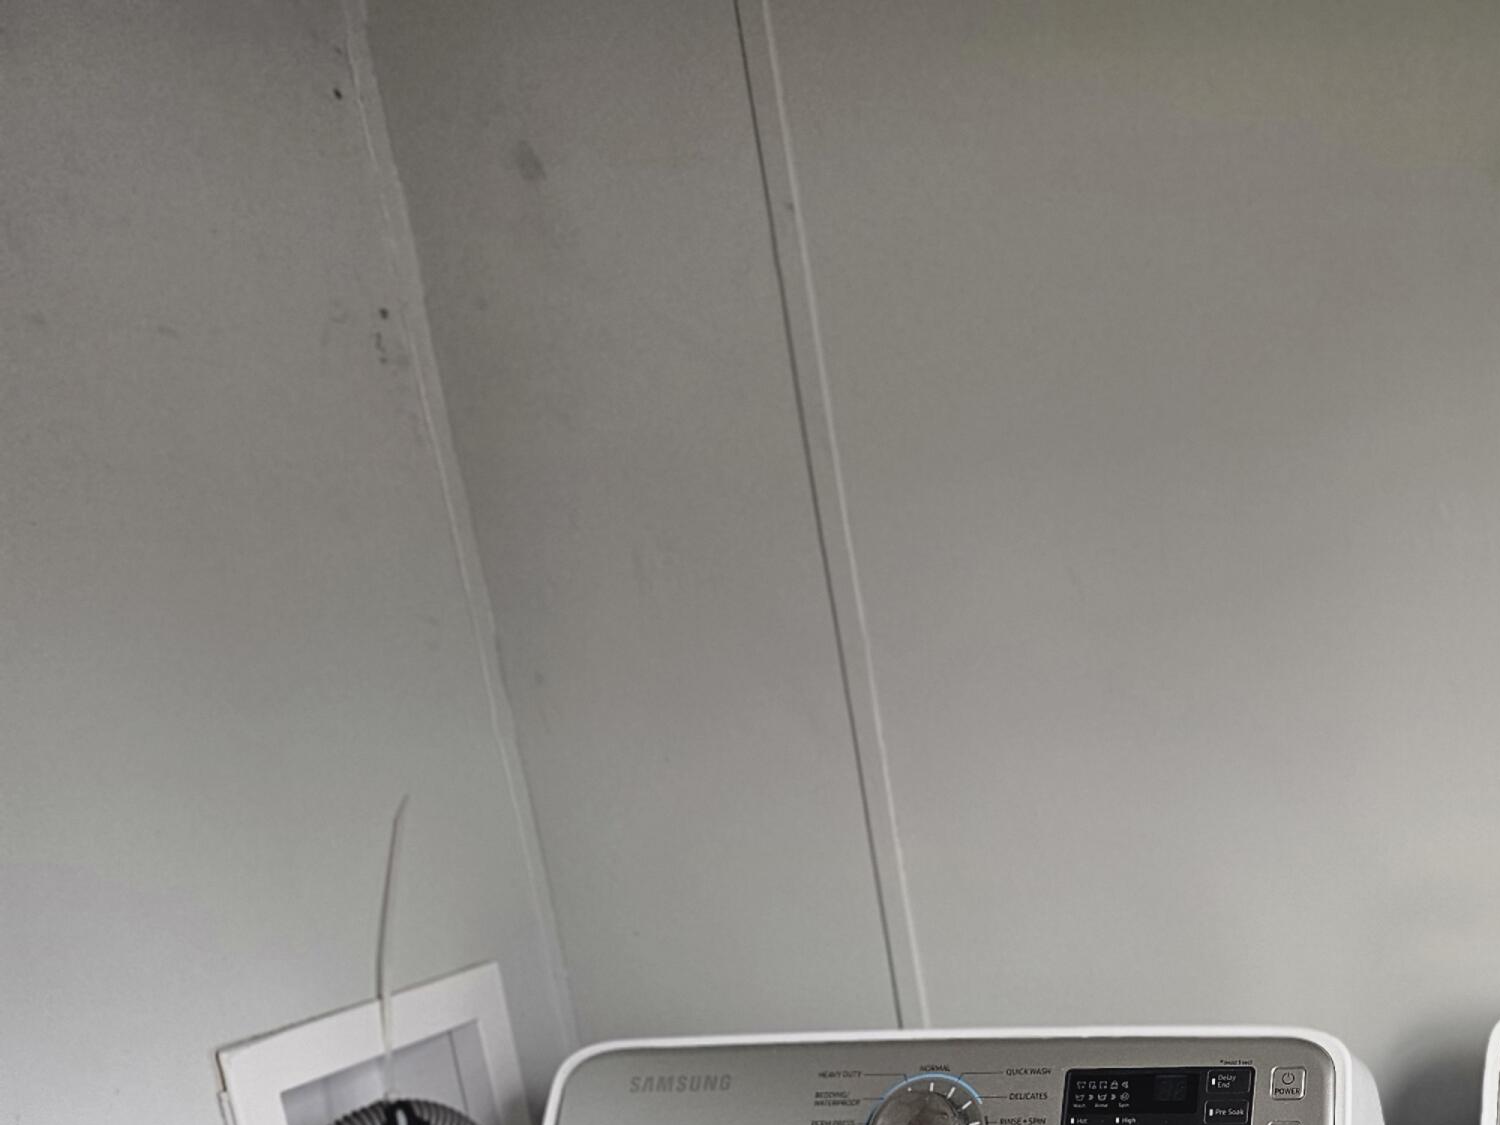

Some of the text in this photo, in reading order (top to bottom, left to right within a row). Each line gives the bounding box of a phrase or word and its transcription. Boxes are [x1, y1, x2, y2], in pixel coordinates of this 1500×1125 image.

[920, 1064, 950, 1072] NORMAL
[1006, 1067, 1051, 1076] QUICK WASH
[1217, 1074, 1236, 1082] Delay
[629, 1074, 733, 1093] SAMSUNG
[1009, 1092, 1048, 1100] DELICATES
[1274, 1088, 1300, 1096] POWER
[1215, 1108, 1244, 1116] Pre Soak
[1028, 1117, 1046, 1125] SPIN
[1121, 1117, 1136, 1125] High
